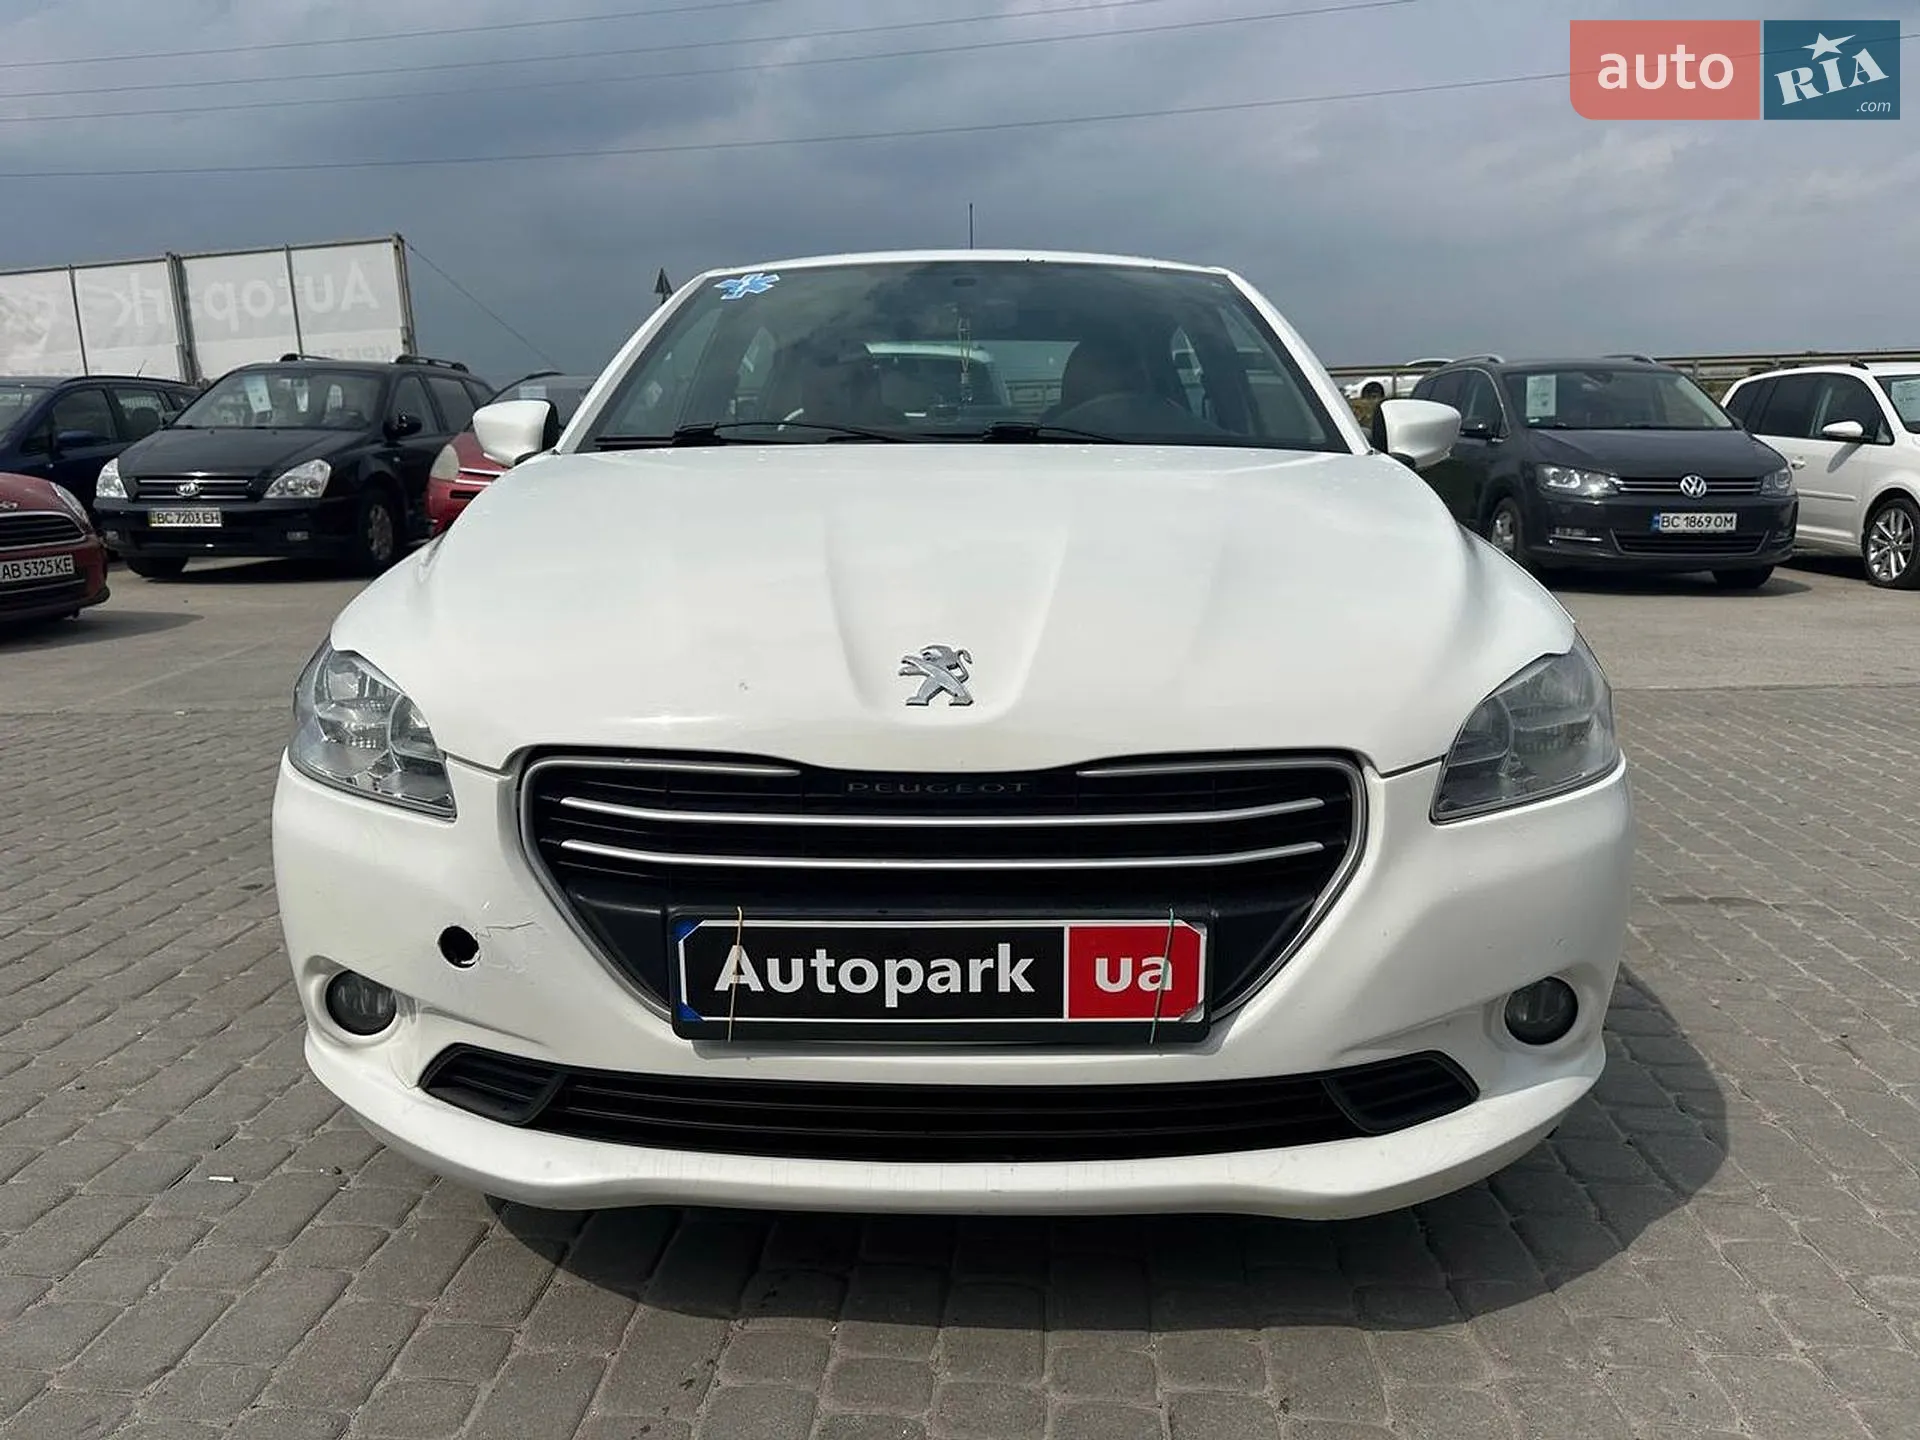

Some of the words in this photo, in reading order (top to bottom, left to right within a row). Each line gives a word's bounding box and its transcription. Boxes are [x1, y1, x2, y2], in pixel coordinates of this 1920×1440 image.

[157, 512, 173, 524] BC
[1661, 515, 1680, 528] BC
[1684, 515, 1712, 528] 1869
[1713, 515, 1734, 528] OM
[2, 563, 21, 579] AB
[847, 782, 1031, 794] PEUGEOT
[714, 943, 1035, 1008] Autopark
[1095, 956, 1174, 992] ua
